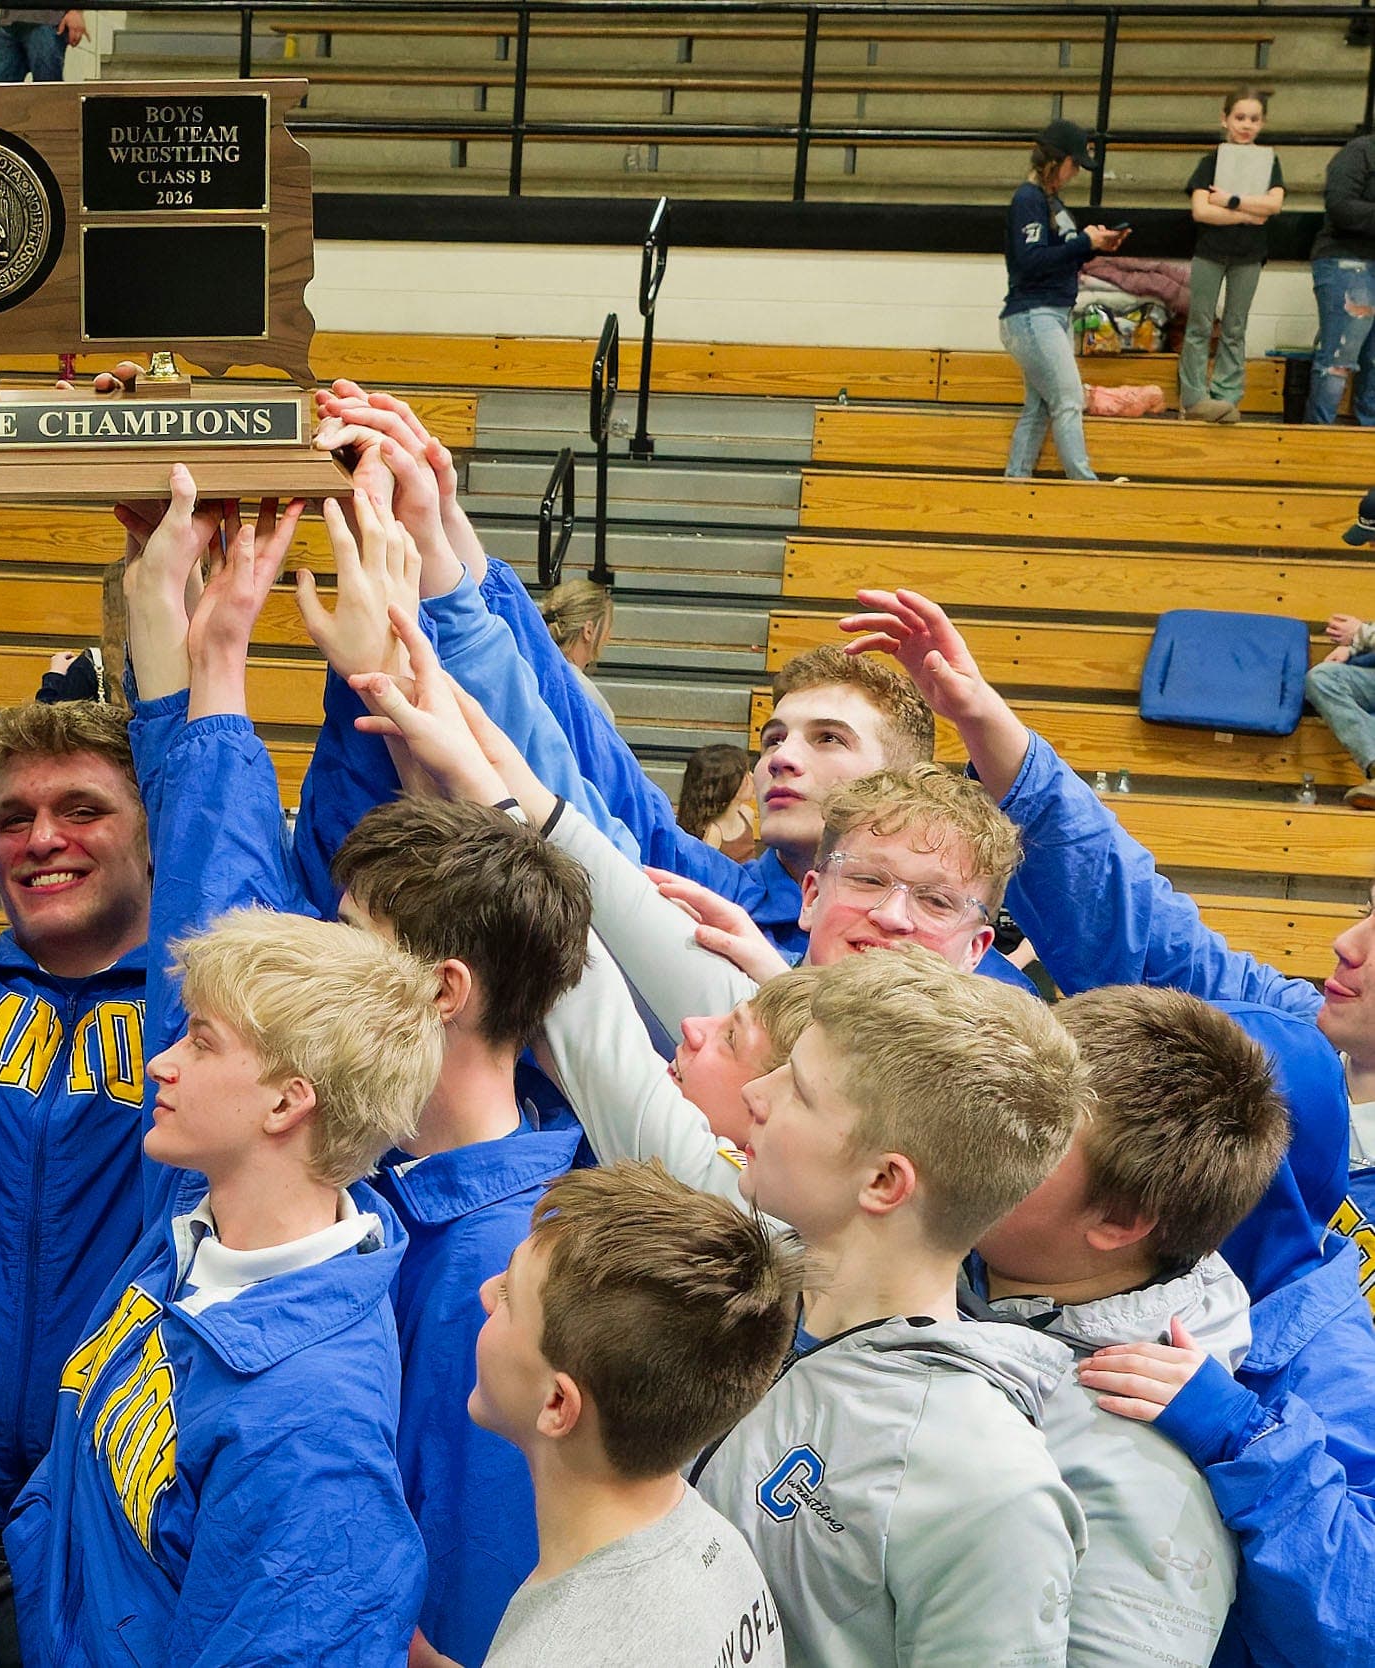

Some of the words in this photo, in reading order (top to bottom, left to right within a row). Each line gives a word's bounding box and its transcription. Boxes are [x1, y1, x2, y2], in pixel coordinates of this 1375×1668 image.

[145, 106, 203, 123] BOYS
[110, 126, 171, 144] DUAL
[174, 125, 239, 143] TEAM
[108, 145, 240, 163] WRESTLING
[137, 169, 196, 184] CLASS
[200, 169, 212, 184] B
[156, 190, 193, 205] 2026
[37, 408, 272, 437] CHAMPIONS
[755, 1443, 826, 1523] C
[787, 1480, 846, 1533] wrestling
[739, 1599, 763, 1664] OF
